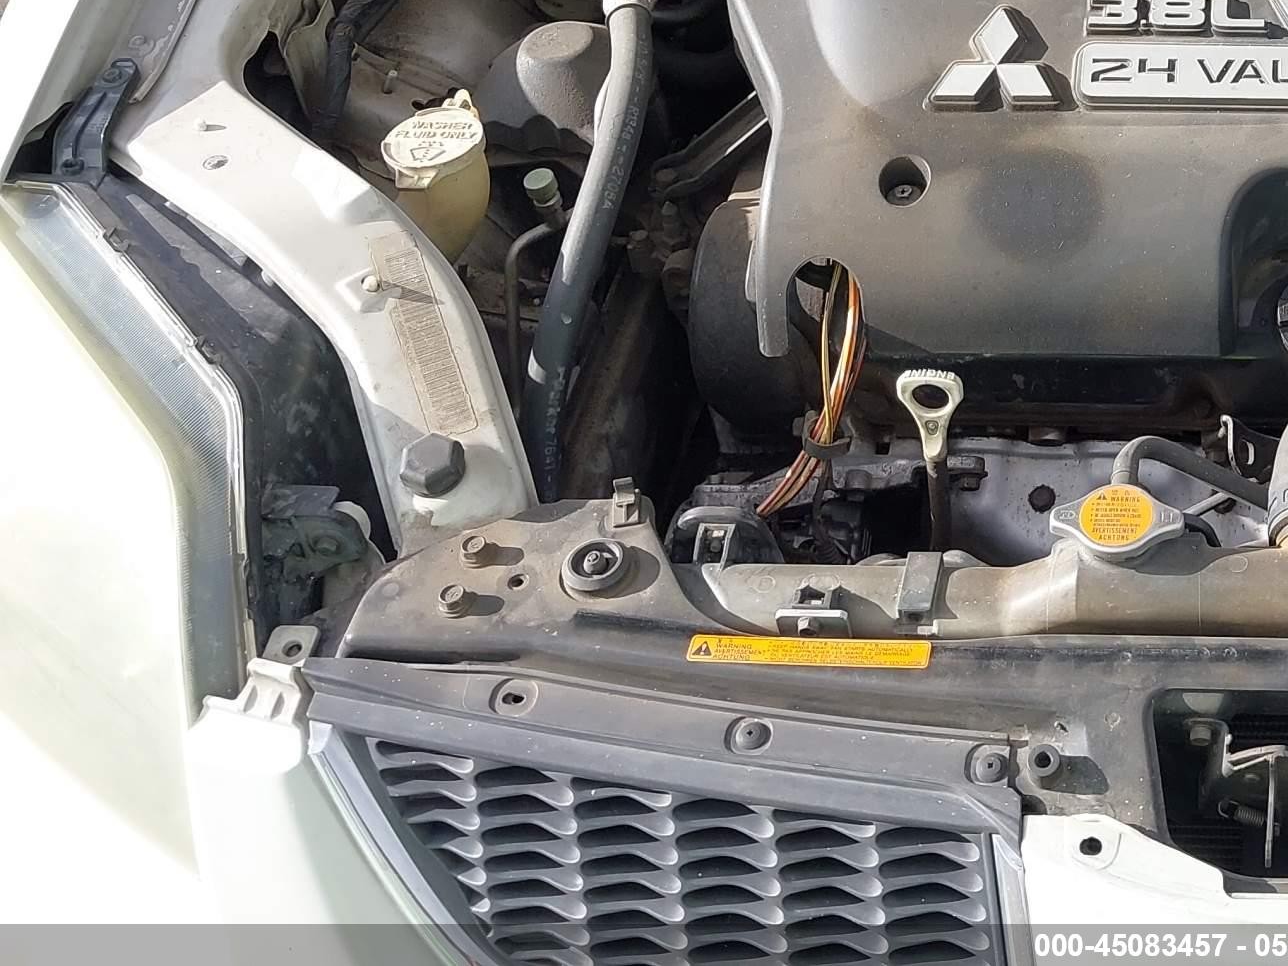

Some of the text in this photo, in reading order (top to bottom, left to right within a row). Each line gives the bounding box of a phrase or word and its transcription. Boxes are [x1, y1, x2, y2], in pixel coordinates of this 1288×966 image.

[1091, 57, 1178, 84] 24
[412, 121, 473, 130] WASHER
[395, 130, 478, 139] FLUID ONLY
[714, 648, 767, 656] AVERTISSEMENT
